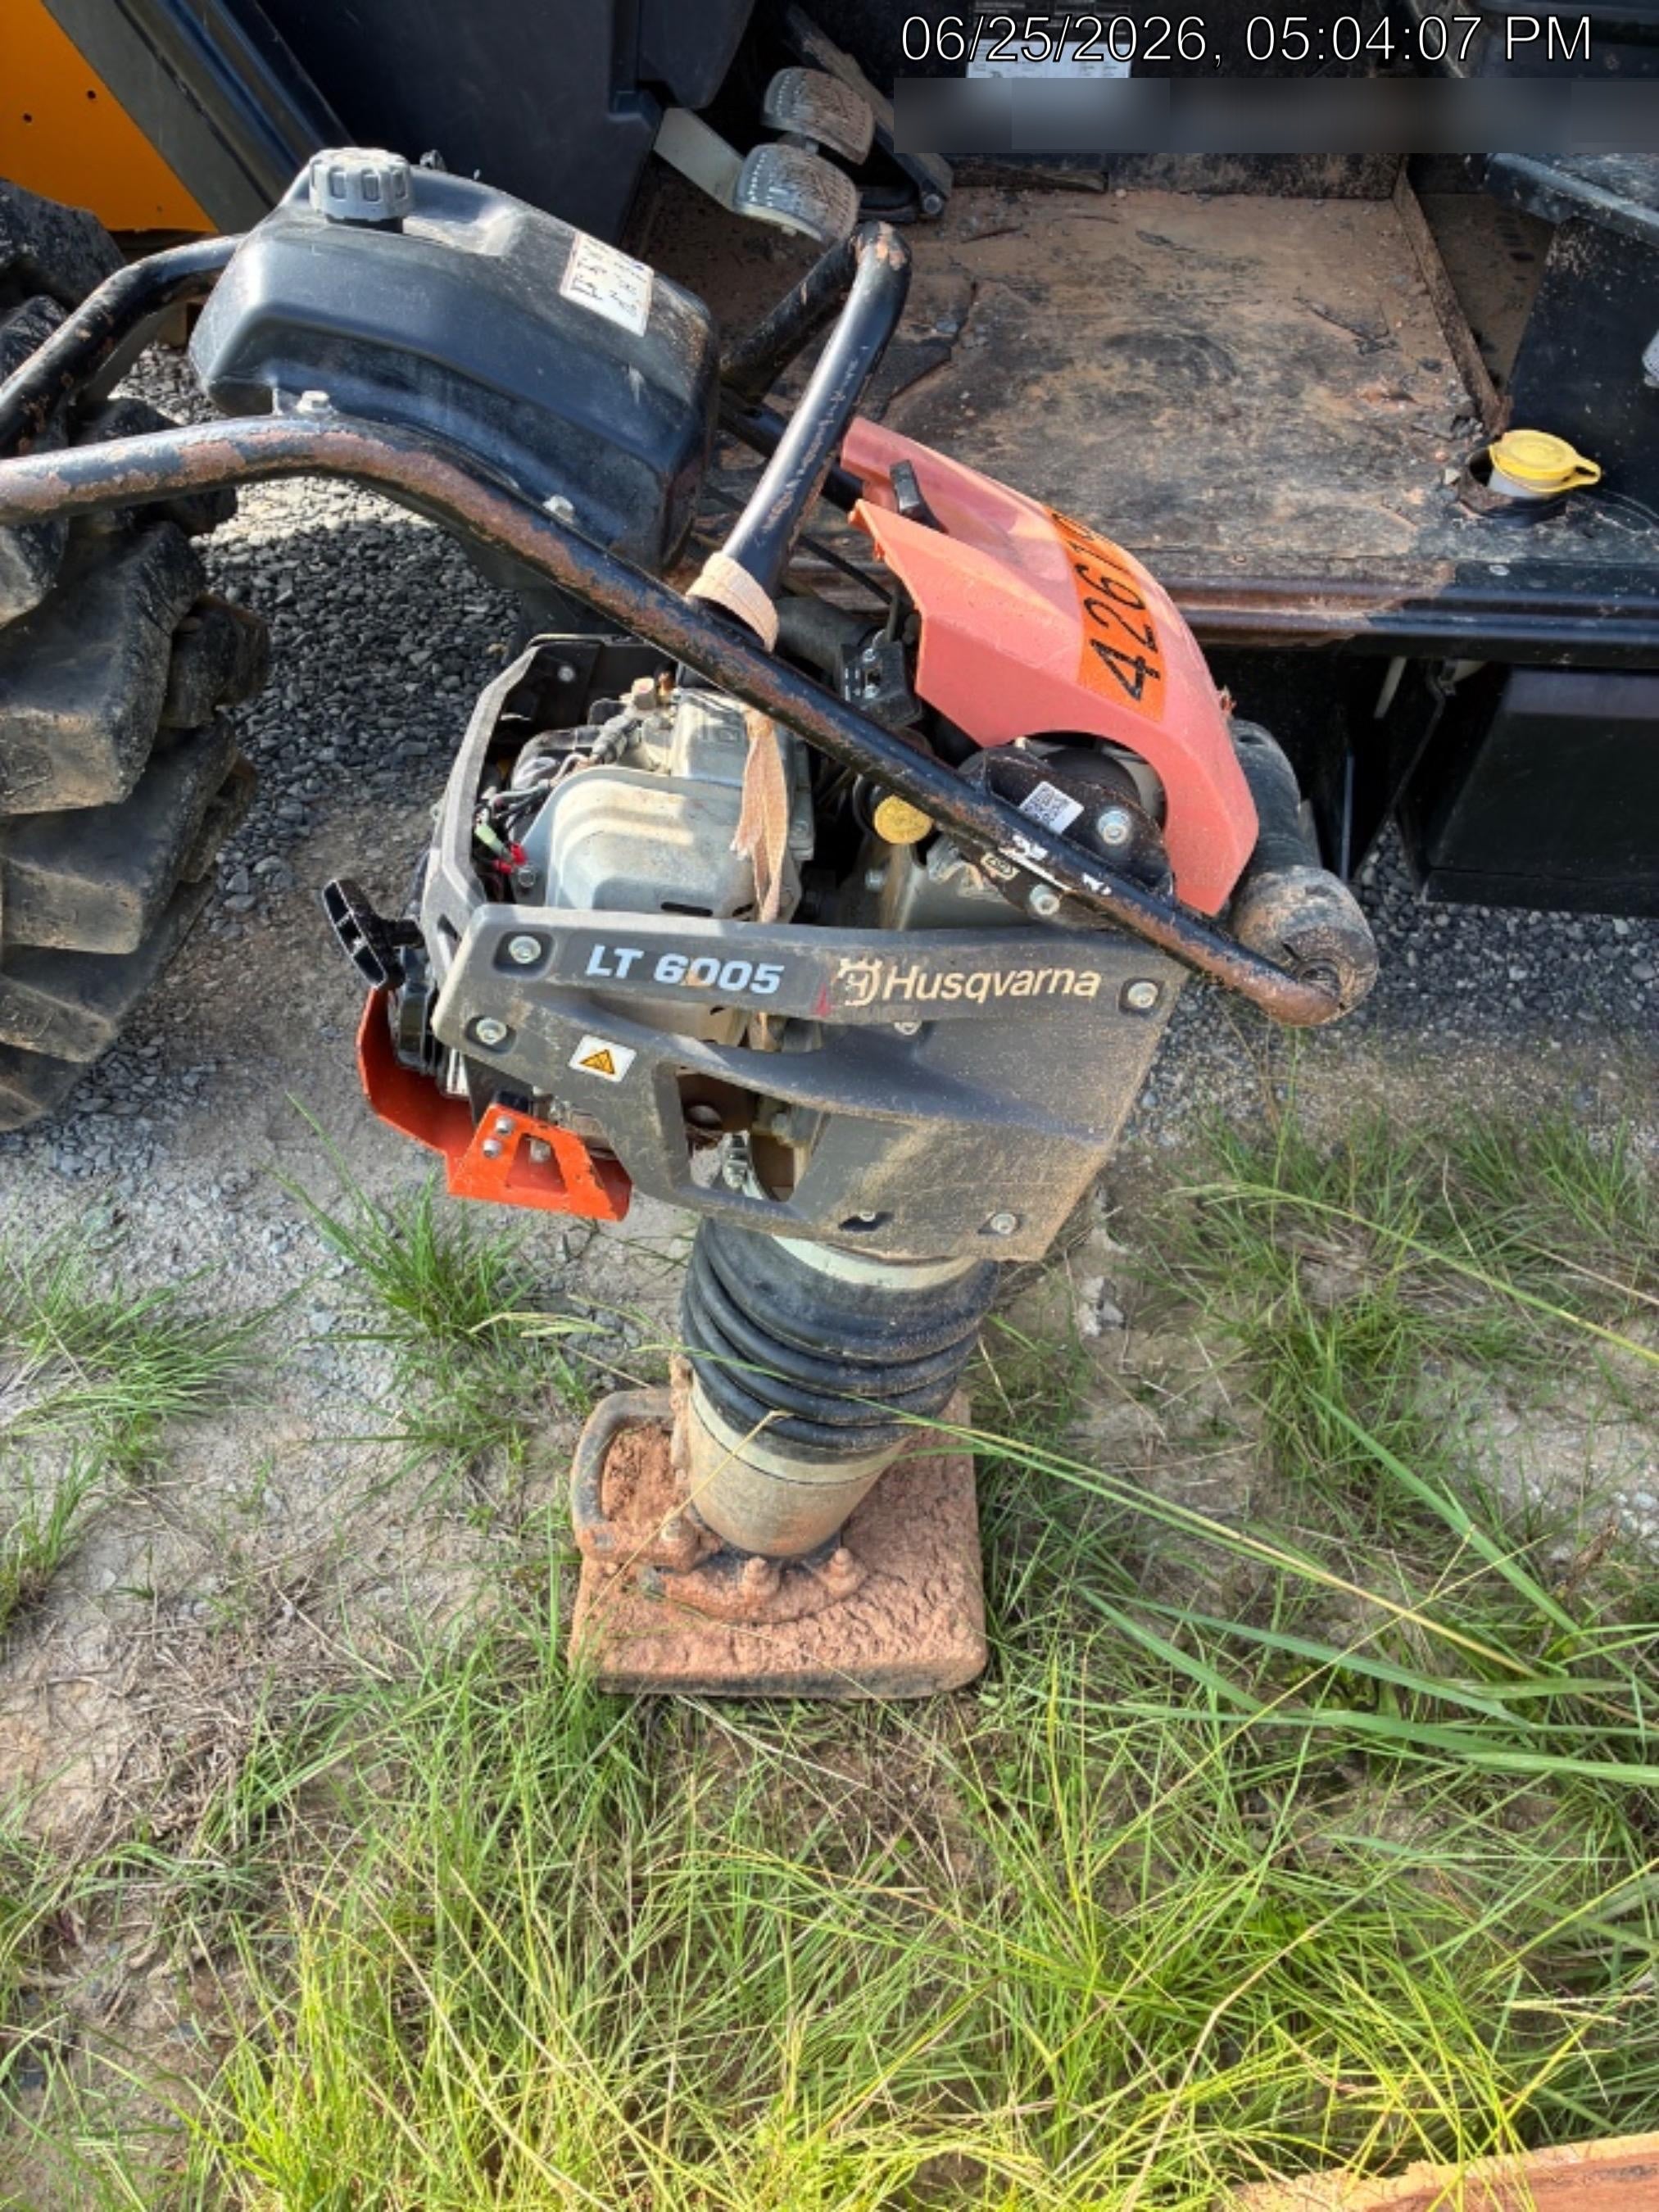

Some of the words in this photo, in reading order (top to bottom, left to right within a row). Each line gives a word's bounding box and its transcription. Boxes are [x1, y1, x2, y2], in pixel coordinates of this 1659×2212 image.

[585, 944, 644, 979] LT
[653, 954, 785, 995] 6005
[882, 964, 1103, 1004] Husqvarna
